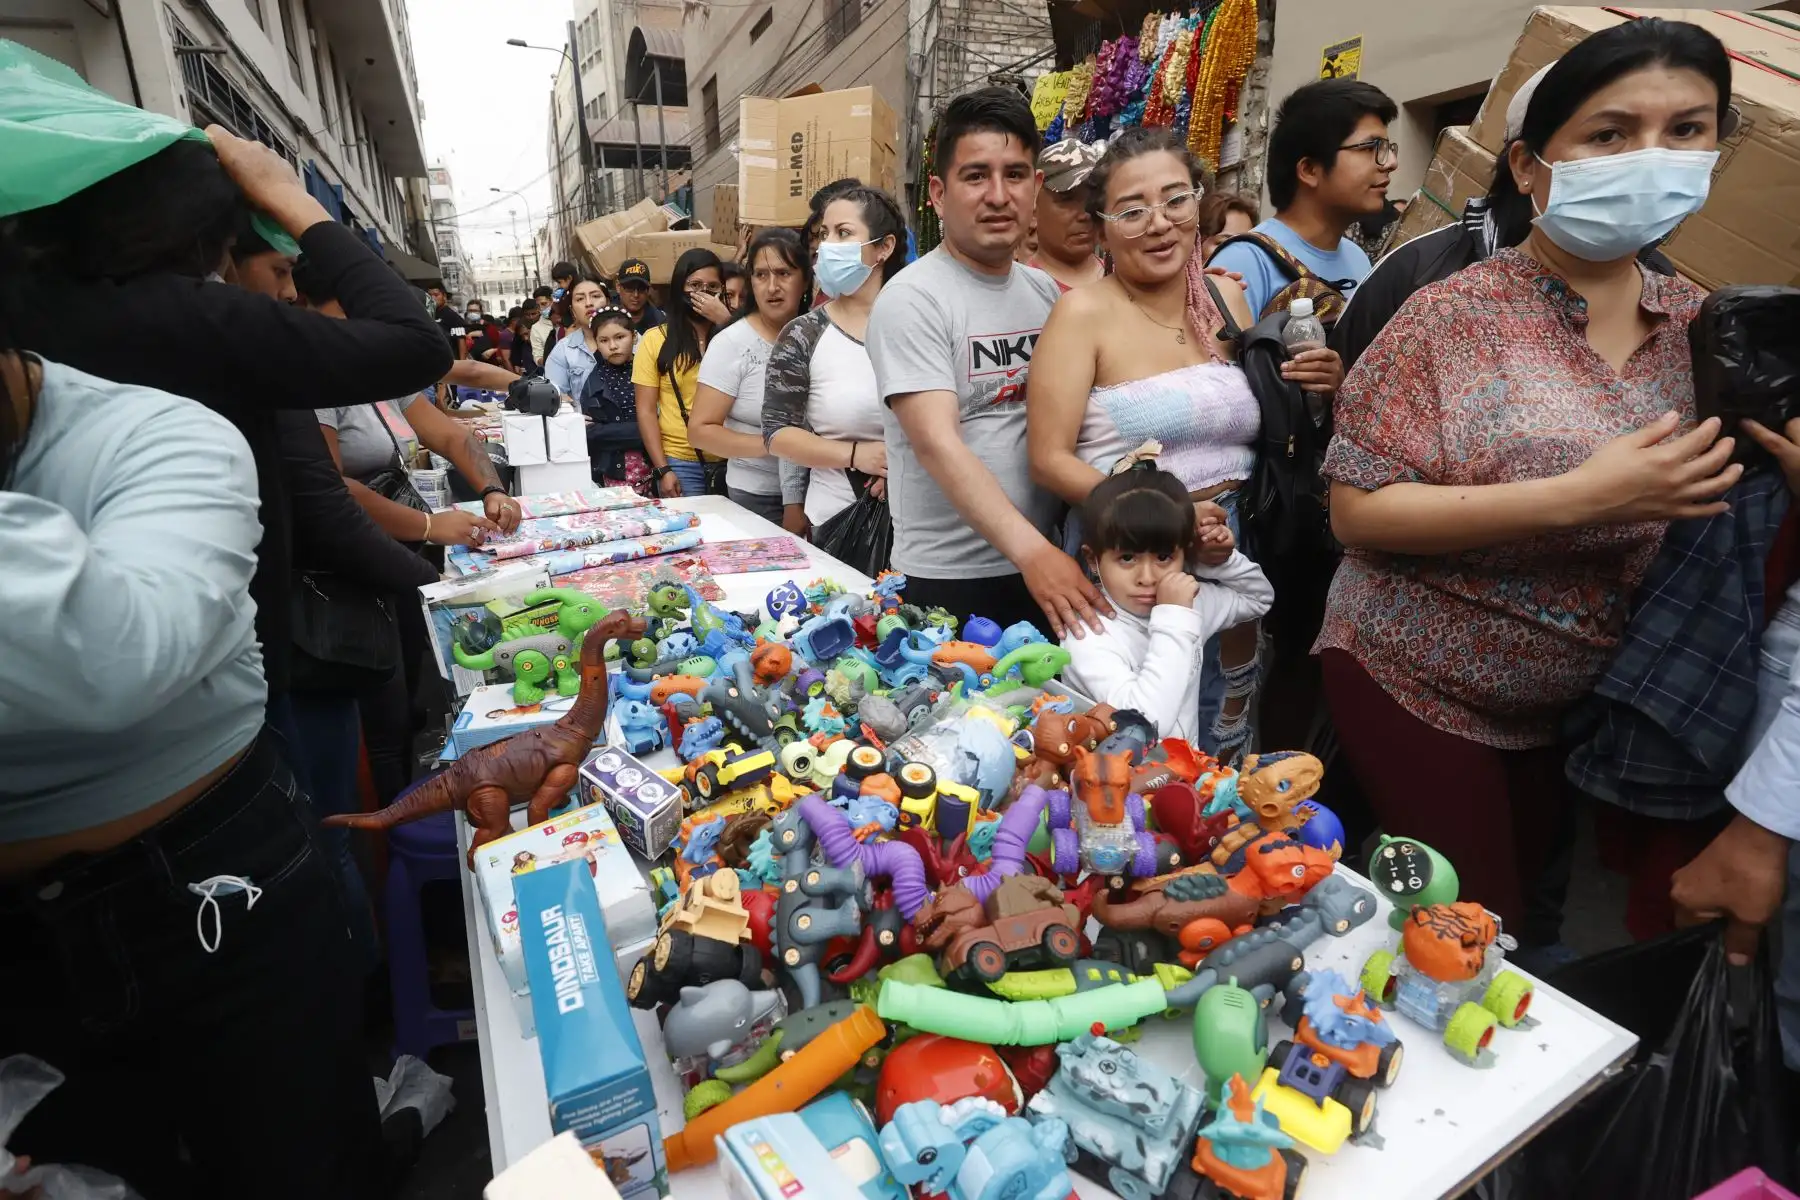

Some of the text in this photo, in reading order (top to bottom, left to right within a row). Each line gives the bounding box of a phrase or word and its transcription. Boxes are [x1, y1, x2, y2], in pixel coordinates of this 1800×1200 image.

[790, 131, 804, 197] HI-MED
[540, 904, 585, 1015] DINOSAUR
[569, 914, 596, 982] TAKE APART
